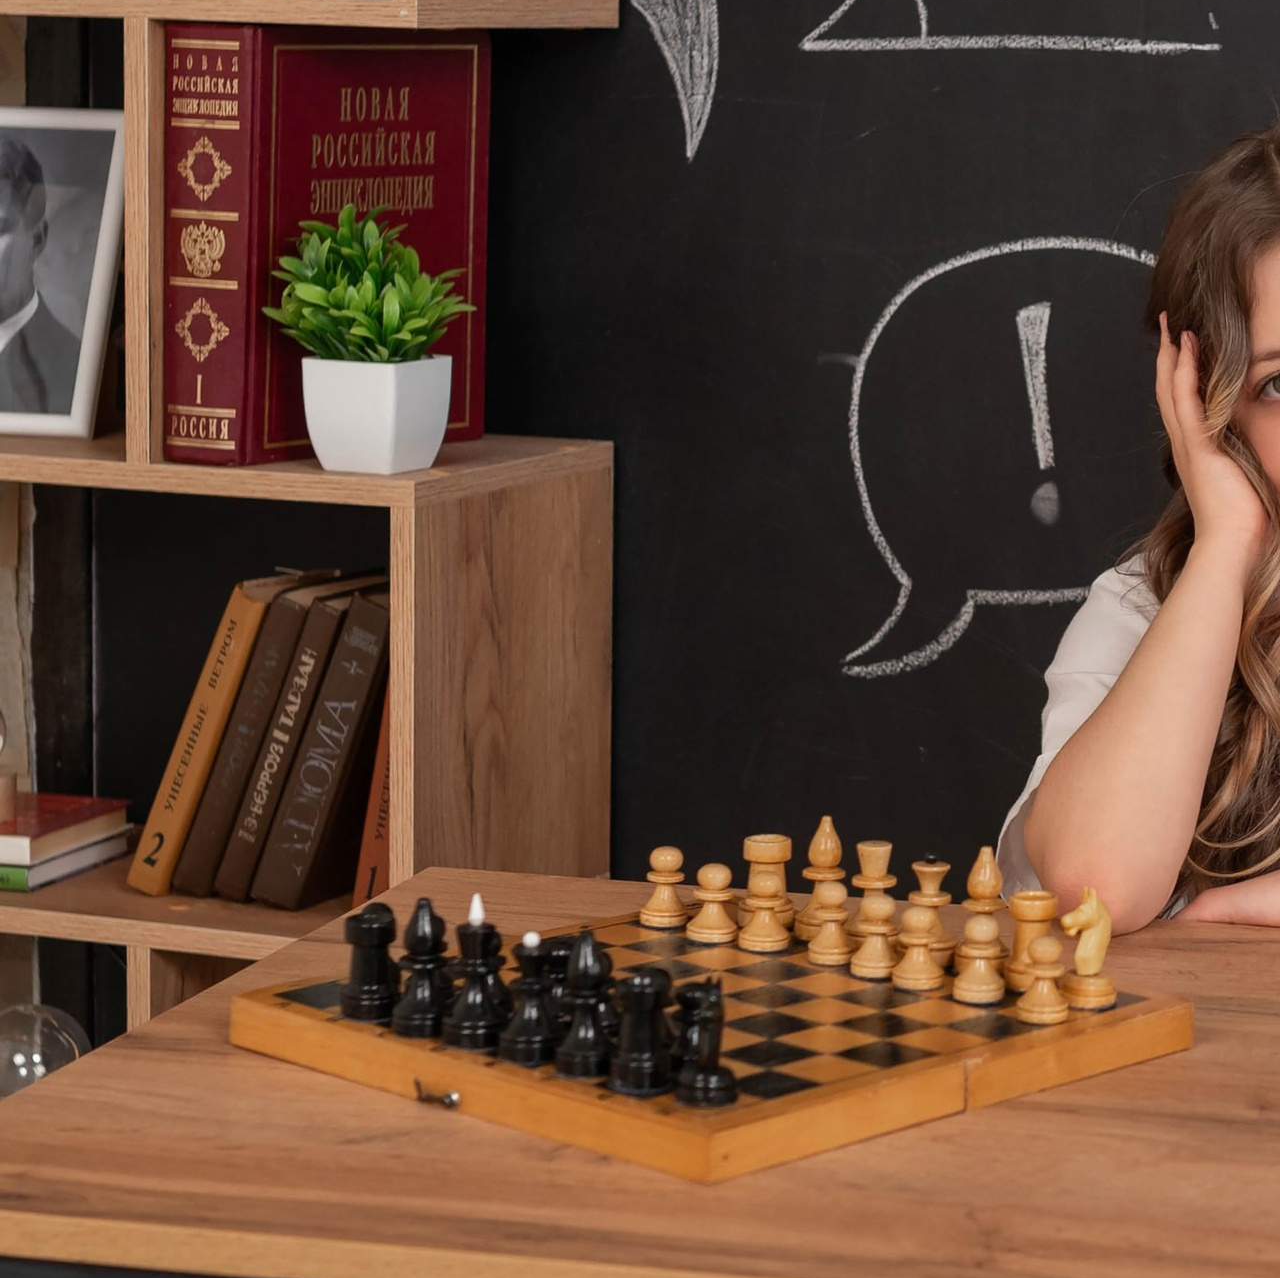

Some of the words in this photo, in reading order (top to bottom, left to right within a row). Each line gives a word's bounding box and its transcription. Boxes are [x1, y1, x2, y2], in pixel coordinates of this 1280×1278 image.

[173, 53, 239, 72] НОВАЯ
[172, 75, 239, 94] РОССИЙСКАЯ
[172, 97, 239, 117] ЭНЦИКЛОПЕДИЯ
[340, 86, 410, 122] НОВАЯ
[311, 126, 436, 169] РОССИЙСКАЯ
[310, 175, 434, 216] ЭНЦИКЛОПЕДИЯ
[171, 415, 229, 440] РОССИЯ
[164, 703, 208, 812] УНЕСЕННЫЕ
[208, 619, 237, 690] ВЕТРОМ
[143, 832, 165, 867] 2
